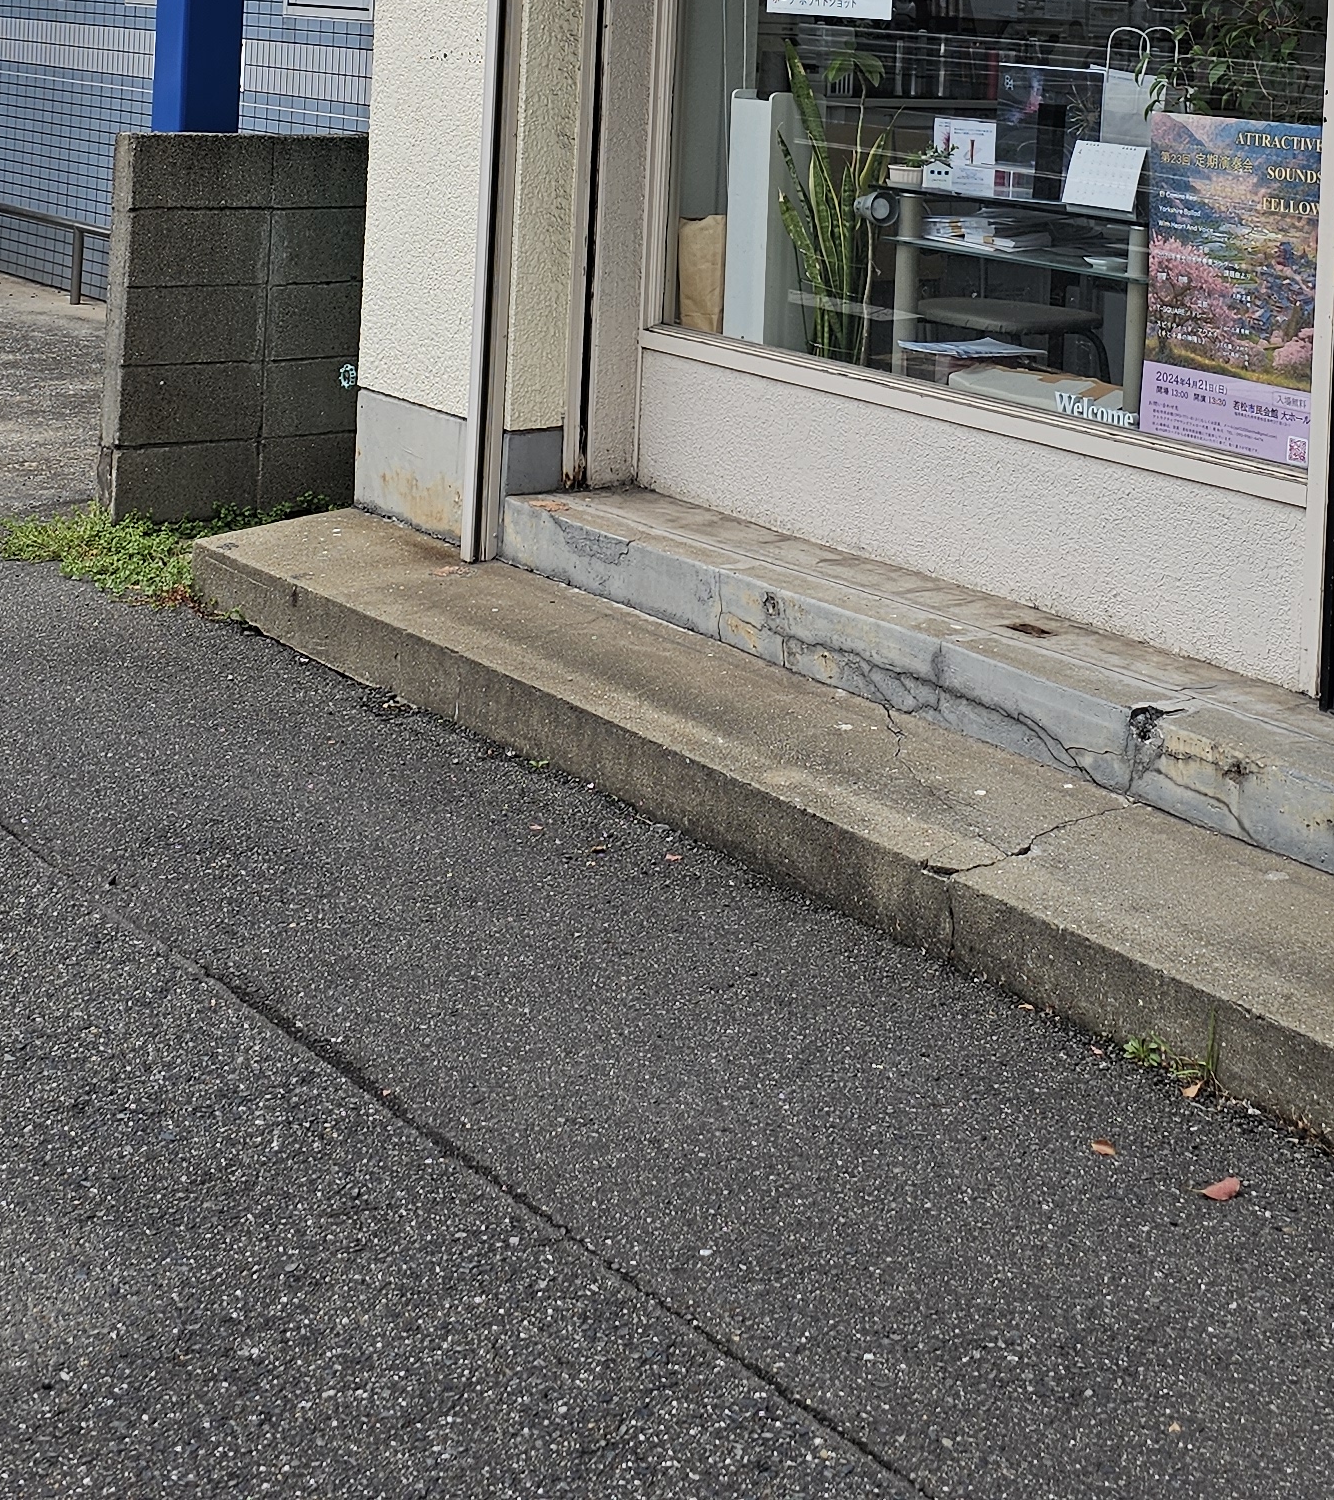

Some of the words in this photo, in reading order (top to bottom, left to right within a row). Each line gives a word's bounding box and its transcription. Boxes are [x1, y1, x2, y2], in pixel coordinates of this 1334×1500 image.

[1160, 151, 1191, 166] 第23回
[1195, 153, 1253, 174] 定期演奏会
[1171, 387, 1189, 400] 13:00
[1055, 391, 1134, 430] Welcome
